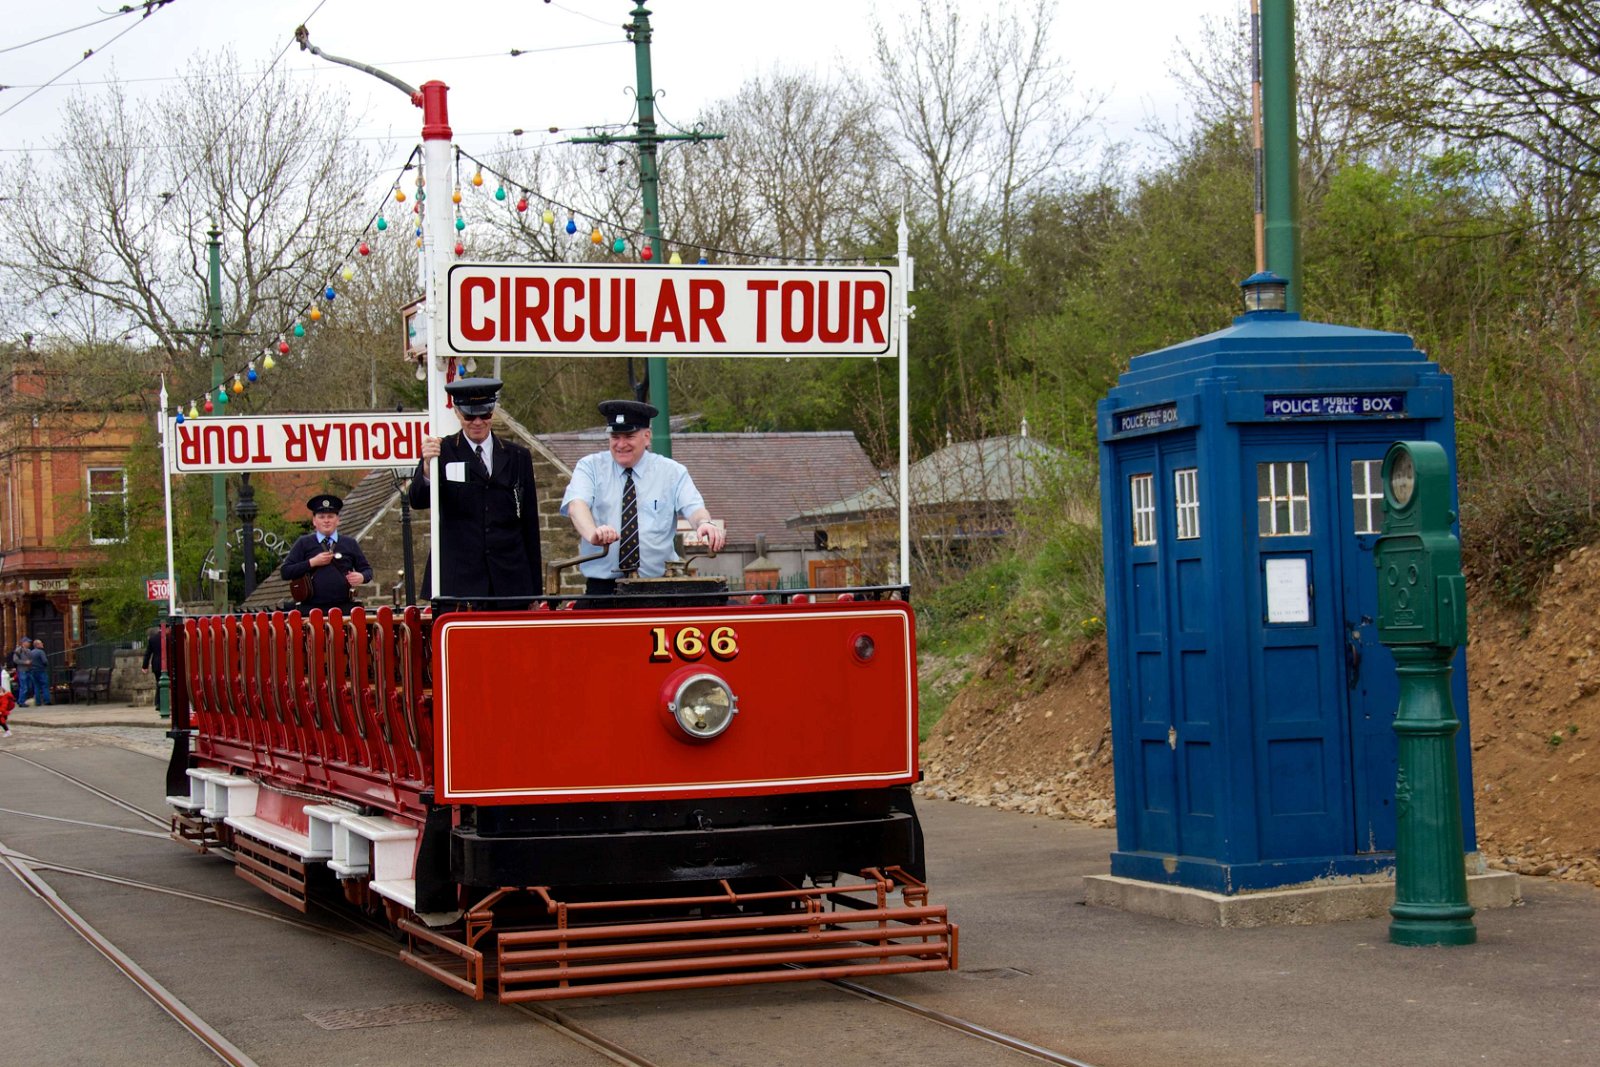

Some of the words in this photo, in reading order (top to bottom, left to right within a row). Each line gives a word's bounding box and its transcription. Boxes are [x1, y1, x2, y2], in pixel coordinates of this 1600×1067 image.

[459, 276, 726, 343] CIRCULAR
[746, 279, 886, 344] TOUR
[1272, 399, 1320, 413] POLICE
[1323, 397, 1358, 405] PUBLIC
[1327, 405, 1354, 413] CALL
[1362, 398, 1393, 411] BOX
[1121, 415, 1143, 430] POLICE
[1162, 408, 1178, 423] BOX
[178, 424, 272, 465] TOUR
[282, 421, 429, 463] IRCULAR
[649, 626, 739, 662] 166
